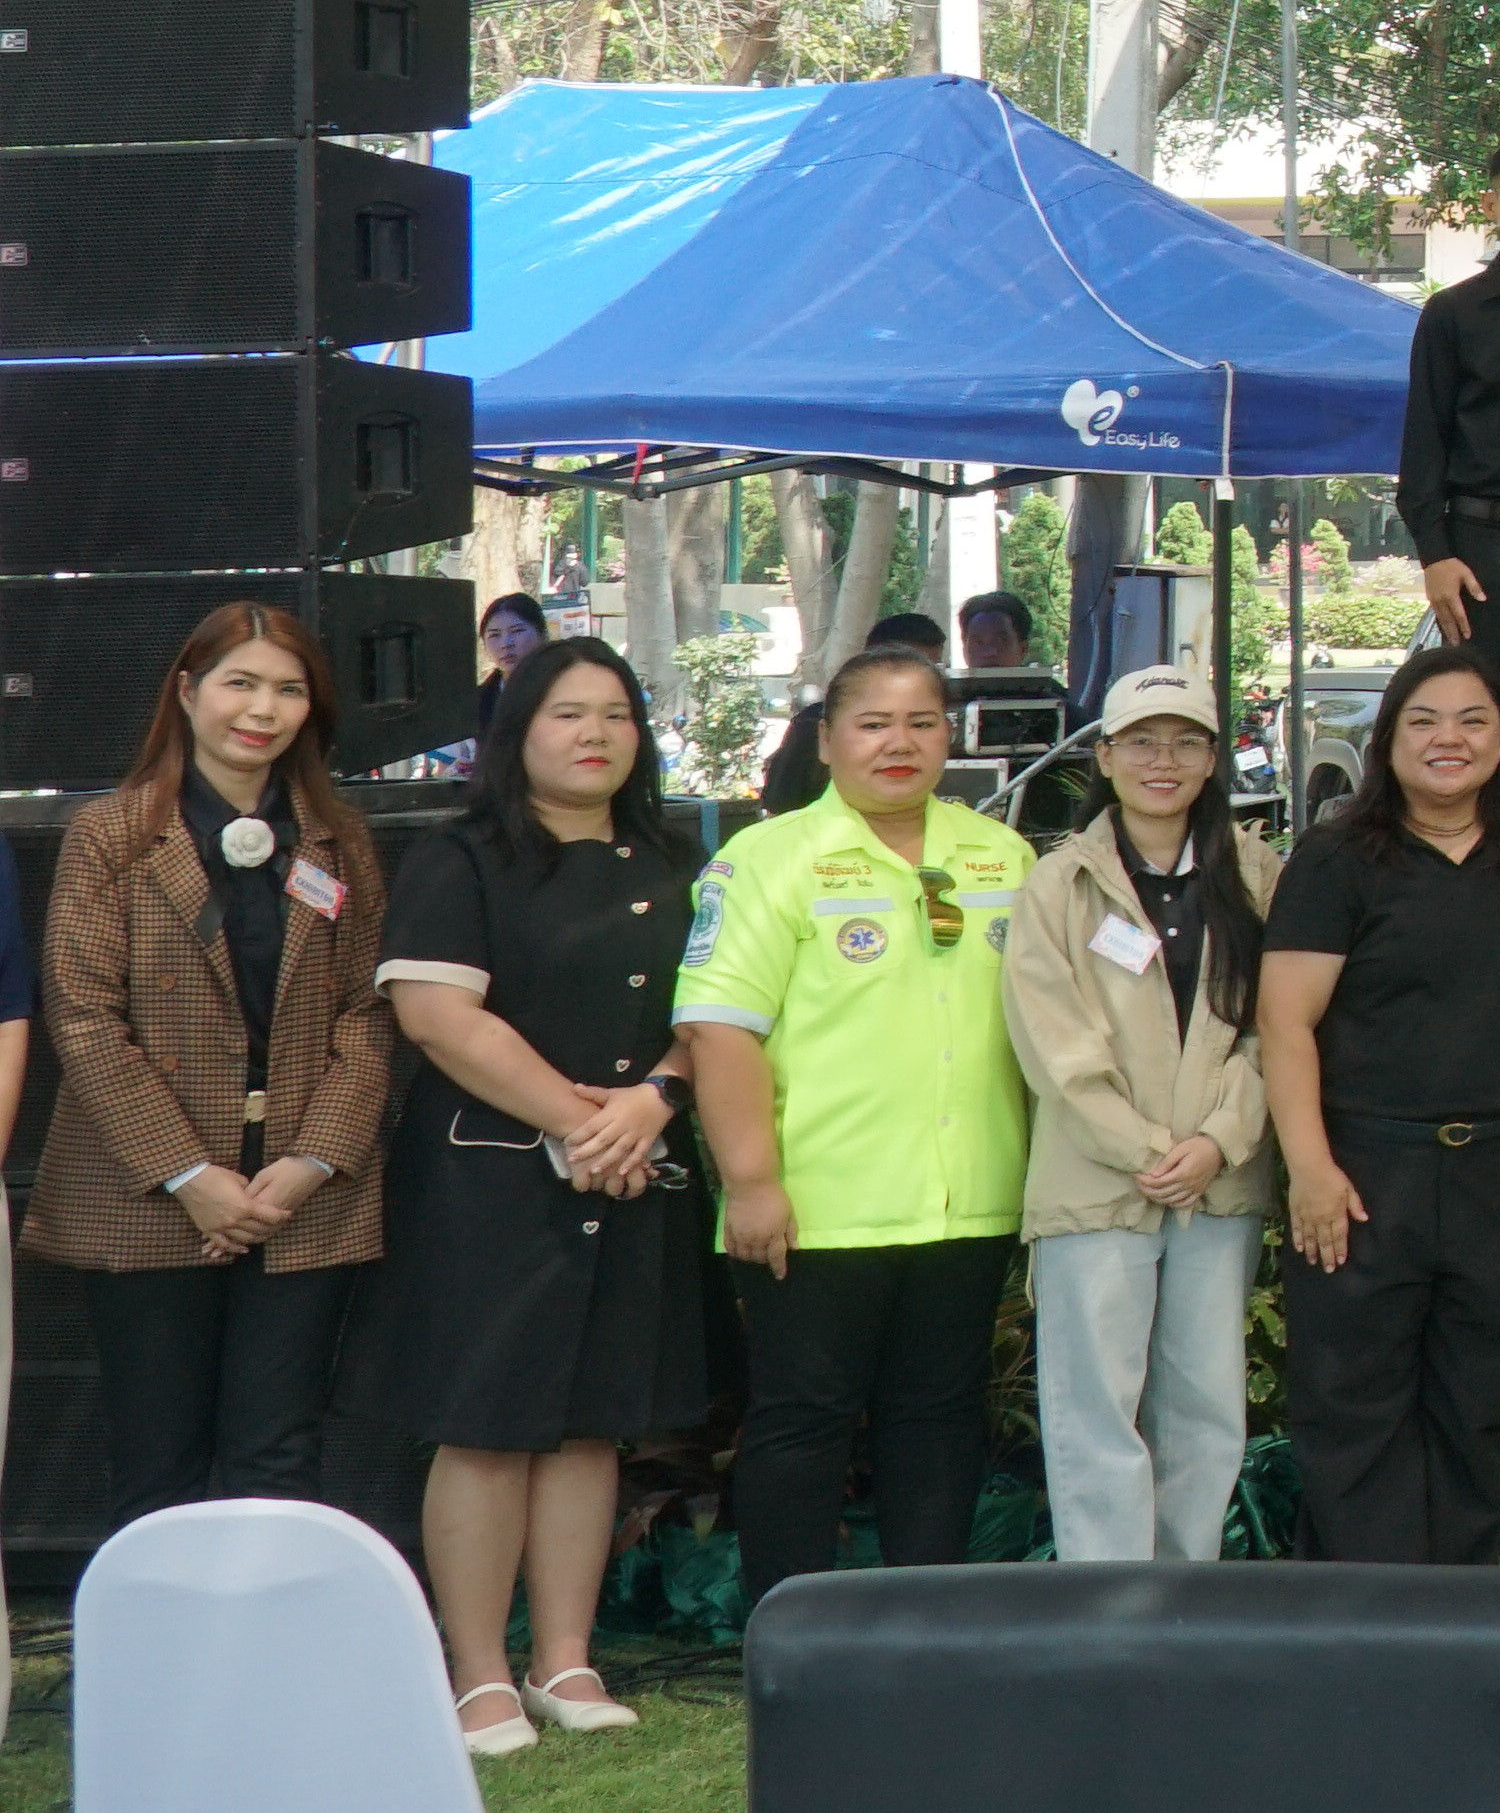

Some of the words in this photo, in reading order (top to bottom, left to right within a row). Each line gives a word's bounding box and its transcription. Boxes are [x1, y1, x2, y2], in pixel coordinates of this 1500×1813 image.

[1105, 430, 1146, 449] Easy
[1150, 431, 1181, 448] Life
[965, 862, 1008, 872] NURSE
